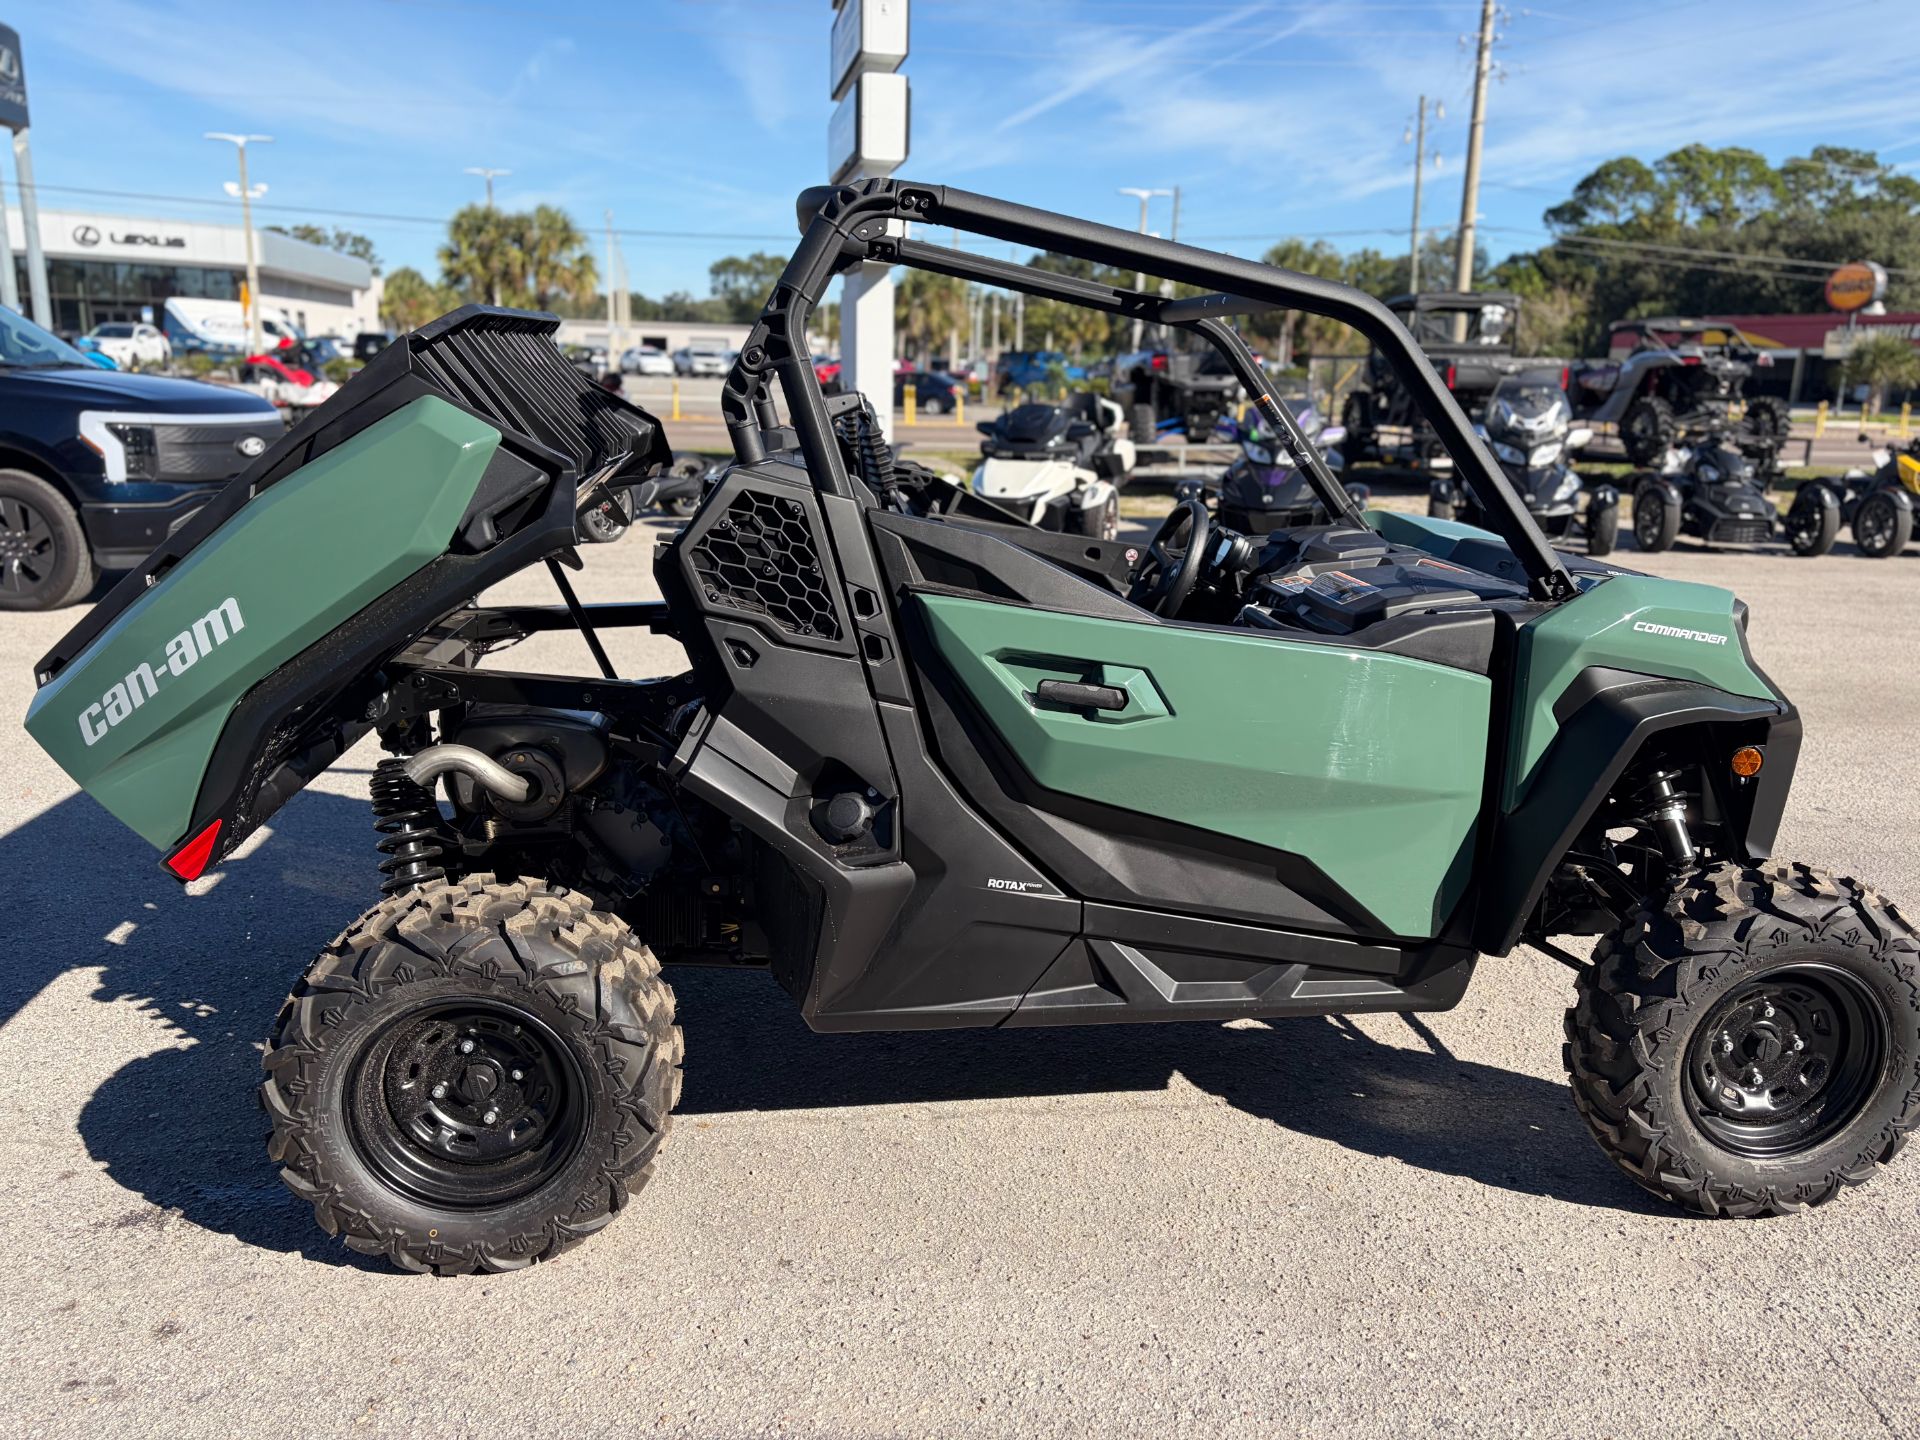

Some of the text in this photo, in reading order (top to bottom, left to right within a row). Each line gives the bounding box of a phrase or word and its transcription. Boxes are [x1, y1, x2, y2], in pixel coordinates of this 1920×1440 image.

[109, 231, 186, 248] LEXUS
[1633, 621, 1728, 645] COMMANDER
[78, 597, 245, 746] can-am
[987, 878, 1026, 891] ROTAX
